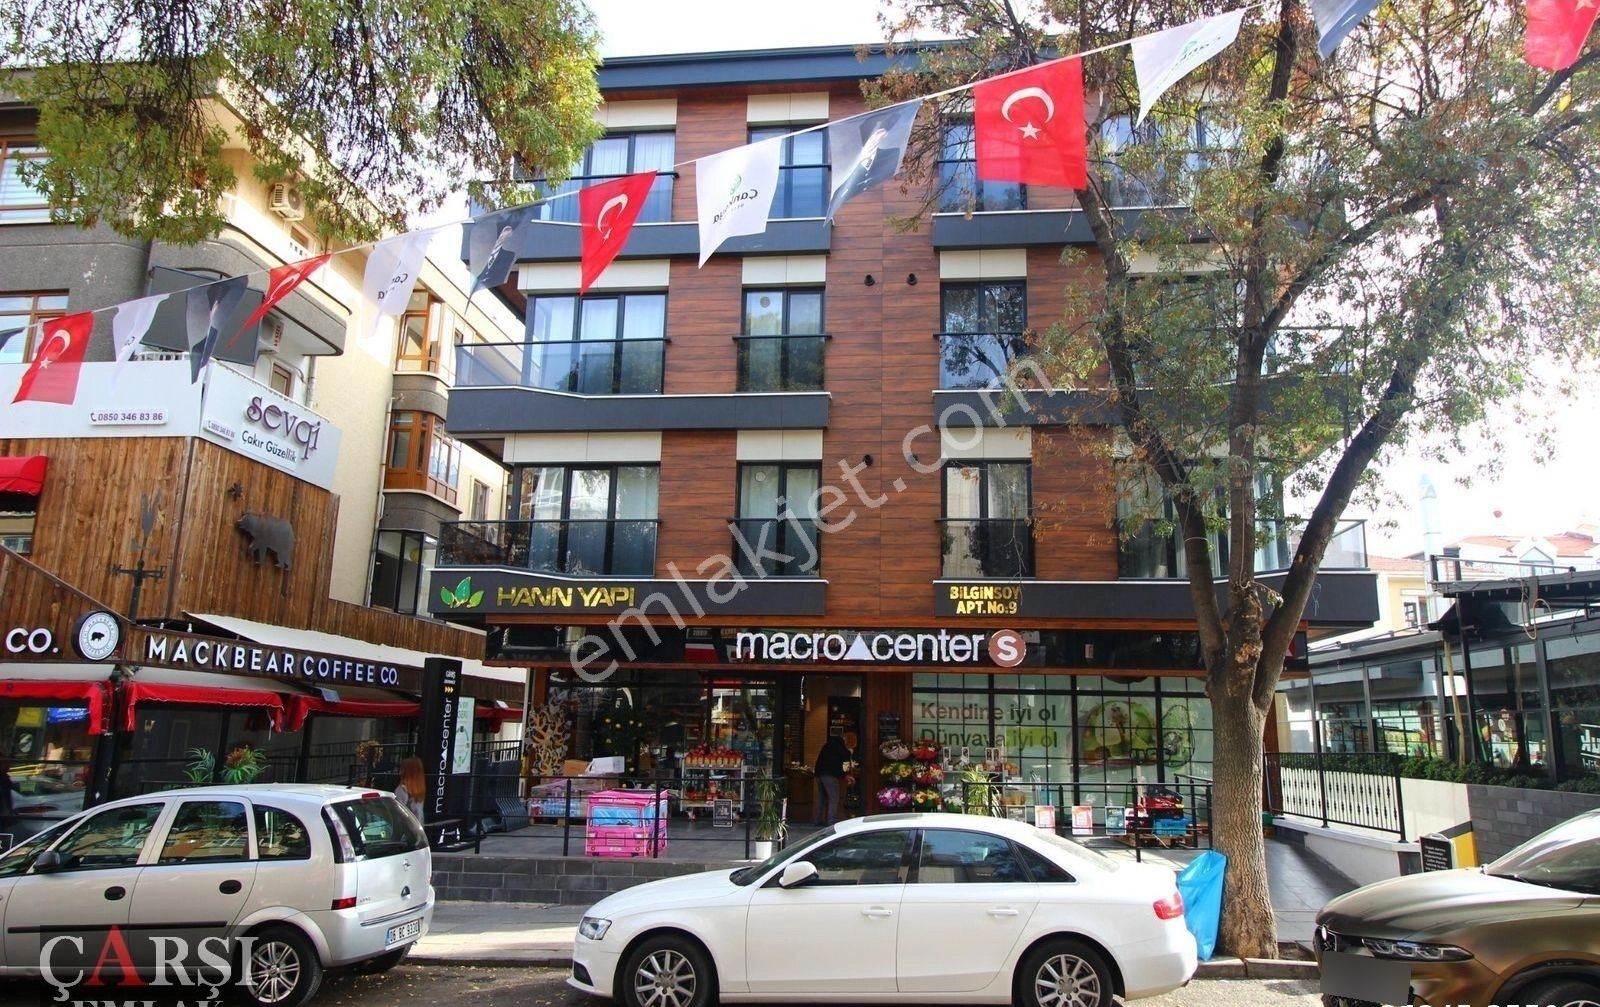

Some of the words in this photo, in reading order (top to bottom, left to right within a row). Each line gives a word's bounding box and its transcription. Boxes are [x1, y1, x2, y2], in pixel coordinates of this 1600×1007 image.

[98, 412, 118, 421] 0850
[121, 412, 137, 421] 346
[139, 412, 150, 421] 83
[152, 412, 163, 421] 86
[241, 430, 264, 449] Çakır
[265, 440, 297, 463] Güzellik
[496, 586, 573, 607] HANN
[577, 587, 635, 607] YAPI
[6, 628, 58, 653] CO.
[148, 635, 294, 674] MACKBEAR
[303, 656, 375, 683] COFFEE
[380, 666, 399, 685] CO.
[1010, 704, 1032, 723] iyi
[1038, 704, 1057, 721] ol
[1013, 728, 1033, 751] iyi
[1040, 730, 1058, 748] ol
